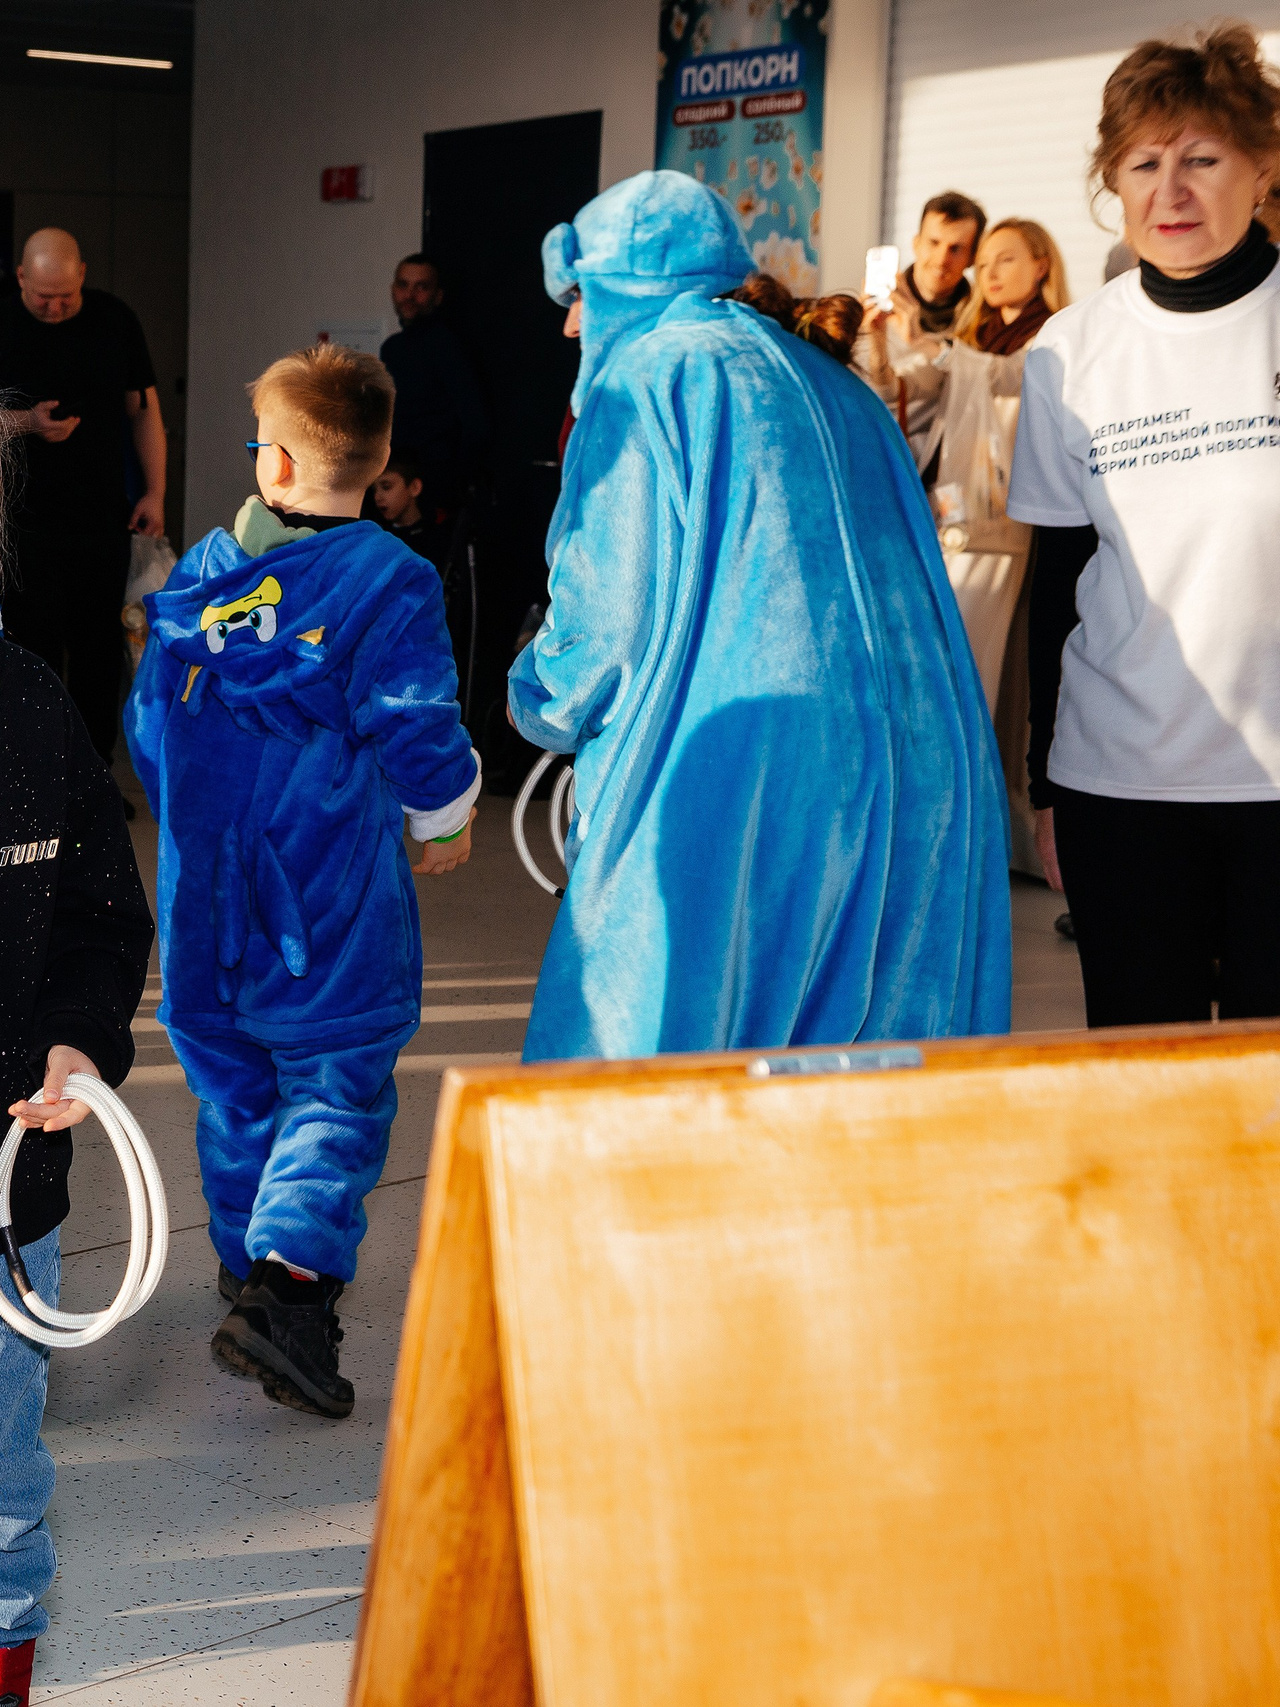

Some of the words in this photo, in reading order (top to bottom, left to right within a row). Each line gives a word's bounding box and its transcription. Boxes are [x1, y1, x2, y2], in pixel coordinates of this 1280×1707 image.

[680, 50, 801, 97] ПОПКОРН
[1088, 445, 1107, 459] ПО
[1111, 420, 1210, 454] СОЦИАЛЬНОЙ
[1214, 414, 1280, 434] ПОЛИТИ
[1091, 408, 1192, 443] ДЕПАРТАМЕНТ
[1089, 457, 1138, 478] МЭРИИ
[1142, 446, 1202, 466] ГОРОДА
[1206, 435, 1280, 456] НОВОСИБ
